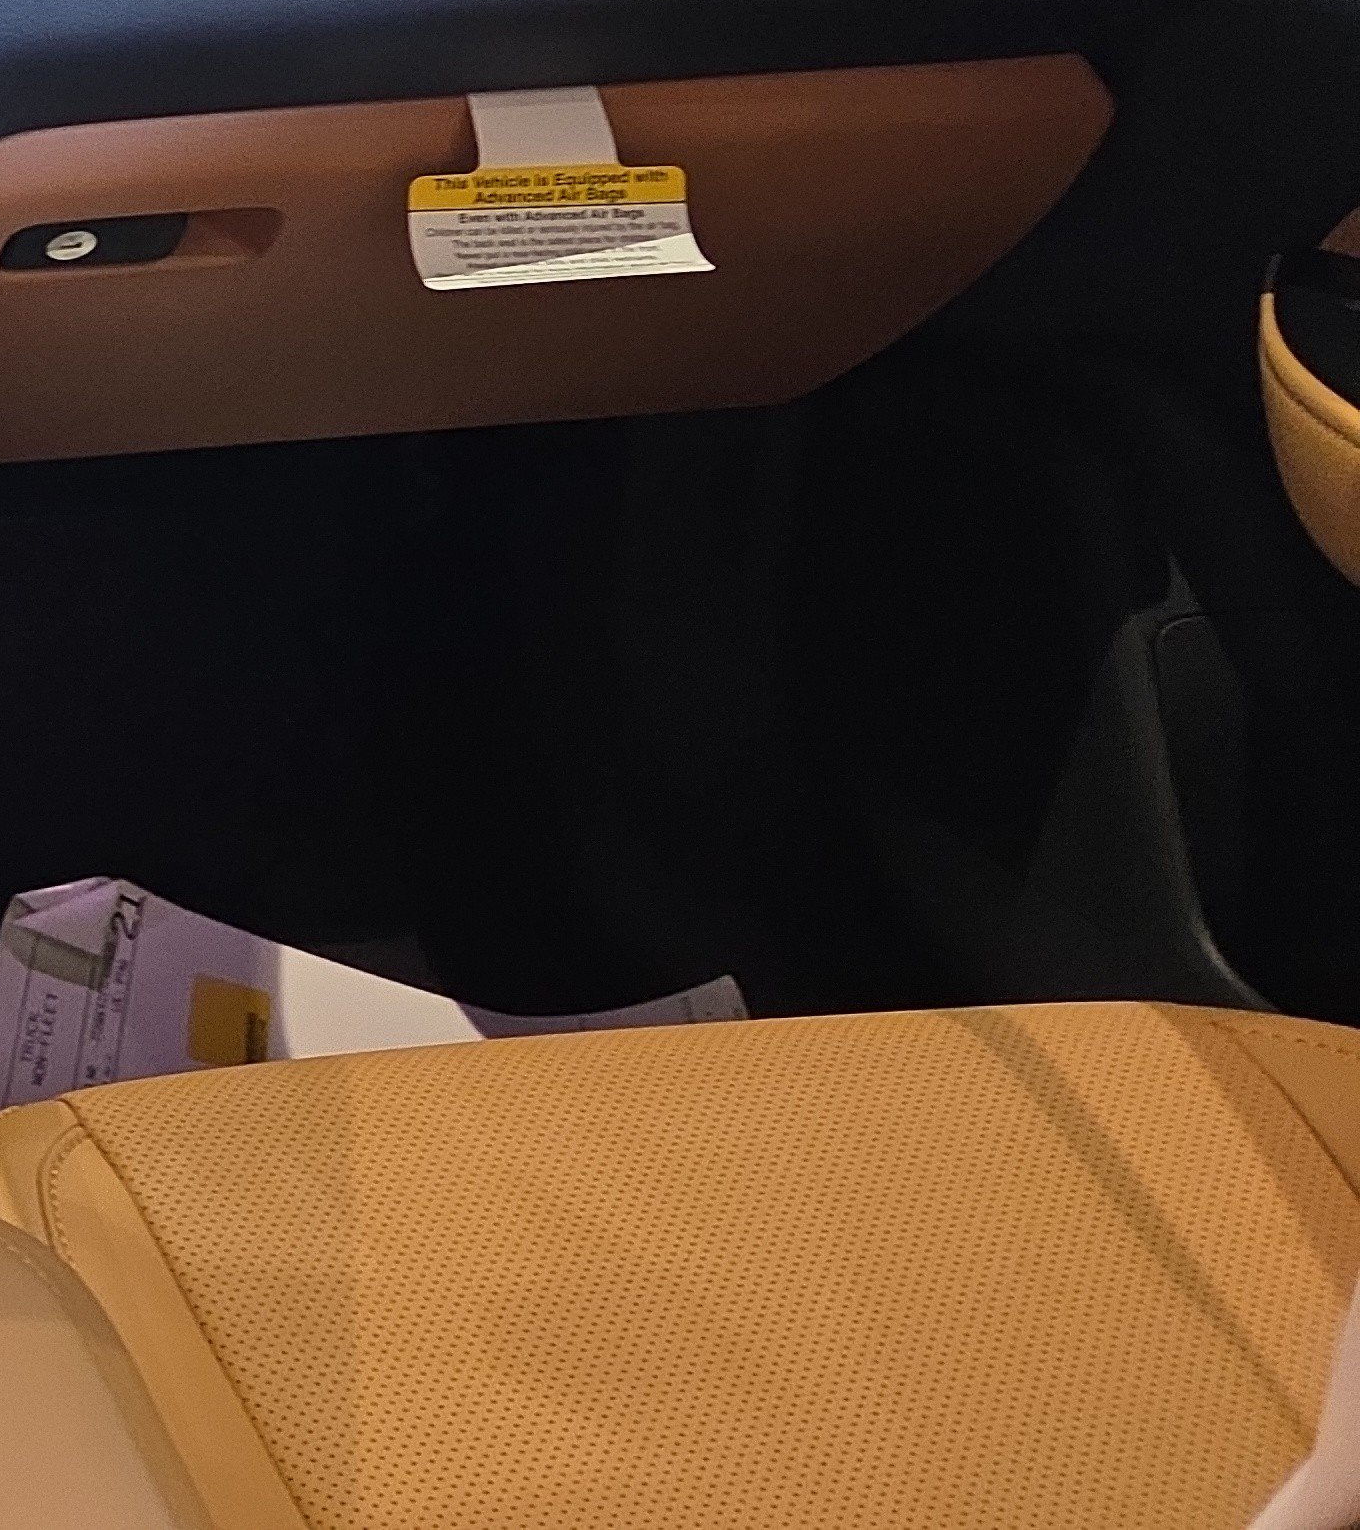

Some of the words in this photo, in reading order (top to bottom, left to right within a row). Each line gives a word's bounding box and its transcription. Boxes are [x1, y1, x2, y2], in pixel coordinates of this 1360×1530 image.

[433, 177, 469, 190] This
[472, 174, 530, 189] Vehicle
[534, 173, 551, 187] is
[554, 171, 631, 189] Equipped
[634, 170, 670, 183] with
[473, 189, 555, 204] Advanced
[558, 188, 584, 201] Air
[586, 187, 628, 203] Bags
[458, 213, 489, 224] Even
[495, 212, 520, 223] with
[524, 209, 588, 222] Advanced
[590, 209, 609, 219] Air
[611, 208, 645, 220] Bags
